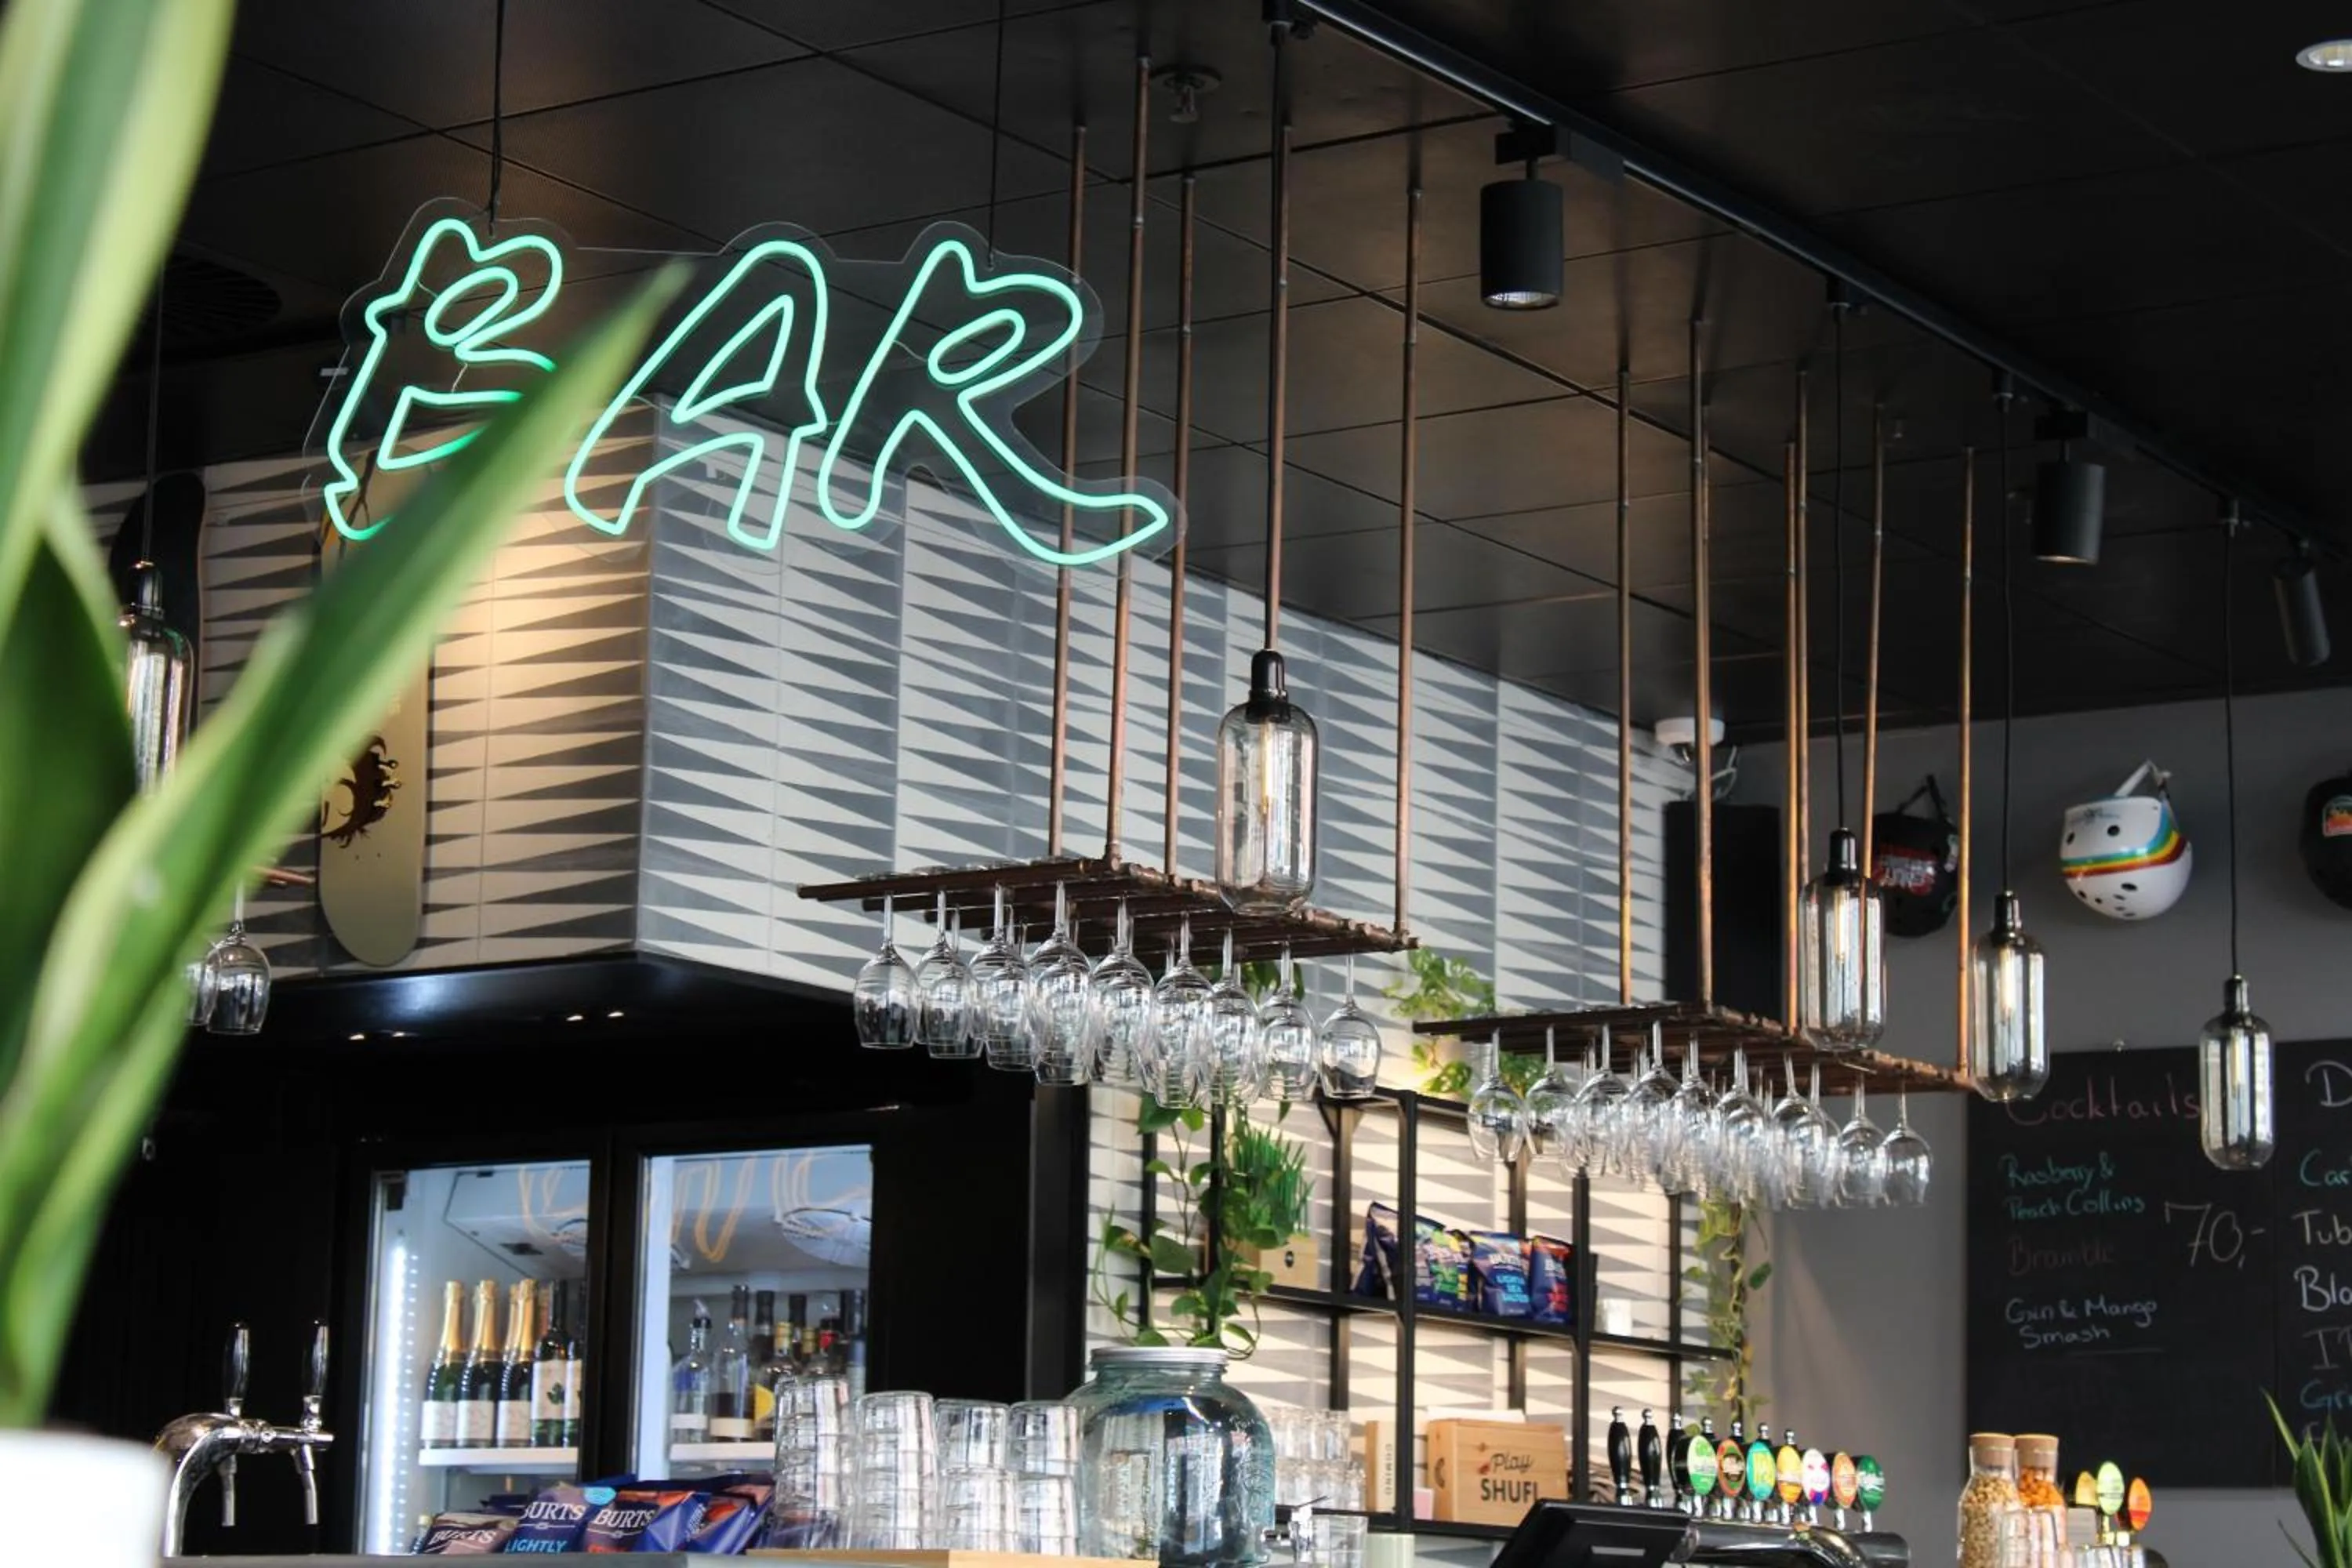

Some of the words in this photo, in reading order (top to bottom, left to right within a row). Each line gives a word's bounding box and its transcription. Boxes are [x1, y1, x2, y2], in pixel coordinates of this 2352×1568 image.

[325, 217, 1169, 565] BAR
[2066, 1189, 2146, 1215] Collins
[2005, 1298, 2053, 1325] Gin
[2085, 1294, 2157, 1327] Mango
[2019, 1325, 2111, 1350] Smash
[1491, 1451, 1534, 1475] Play
[506, 1539, 568, 1553] LIGHTLY
